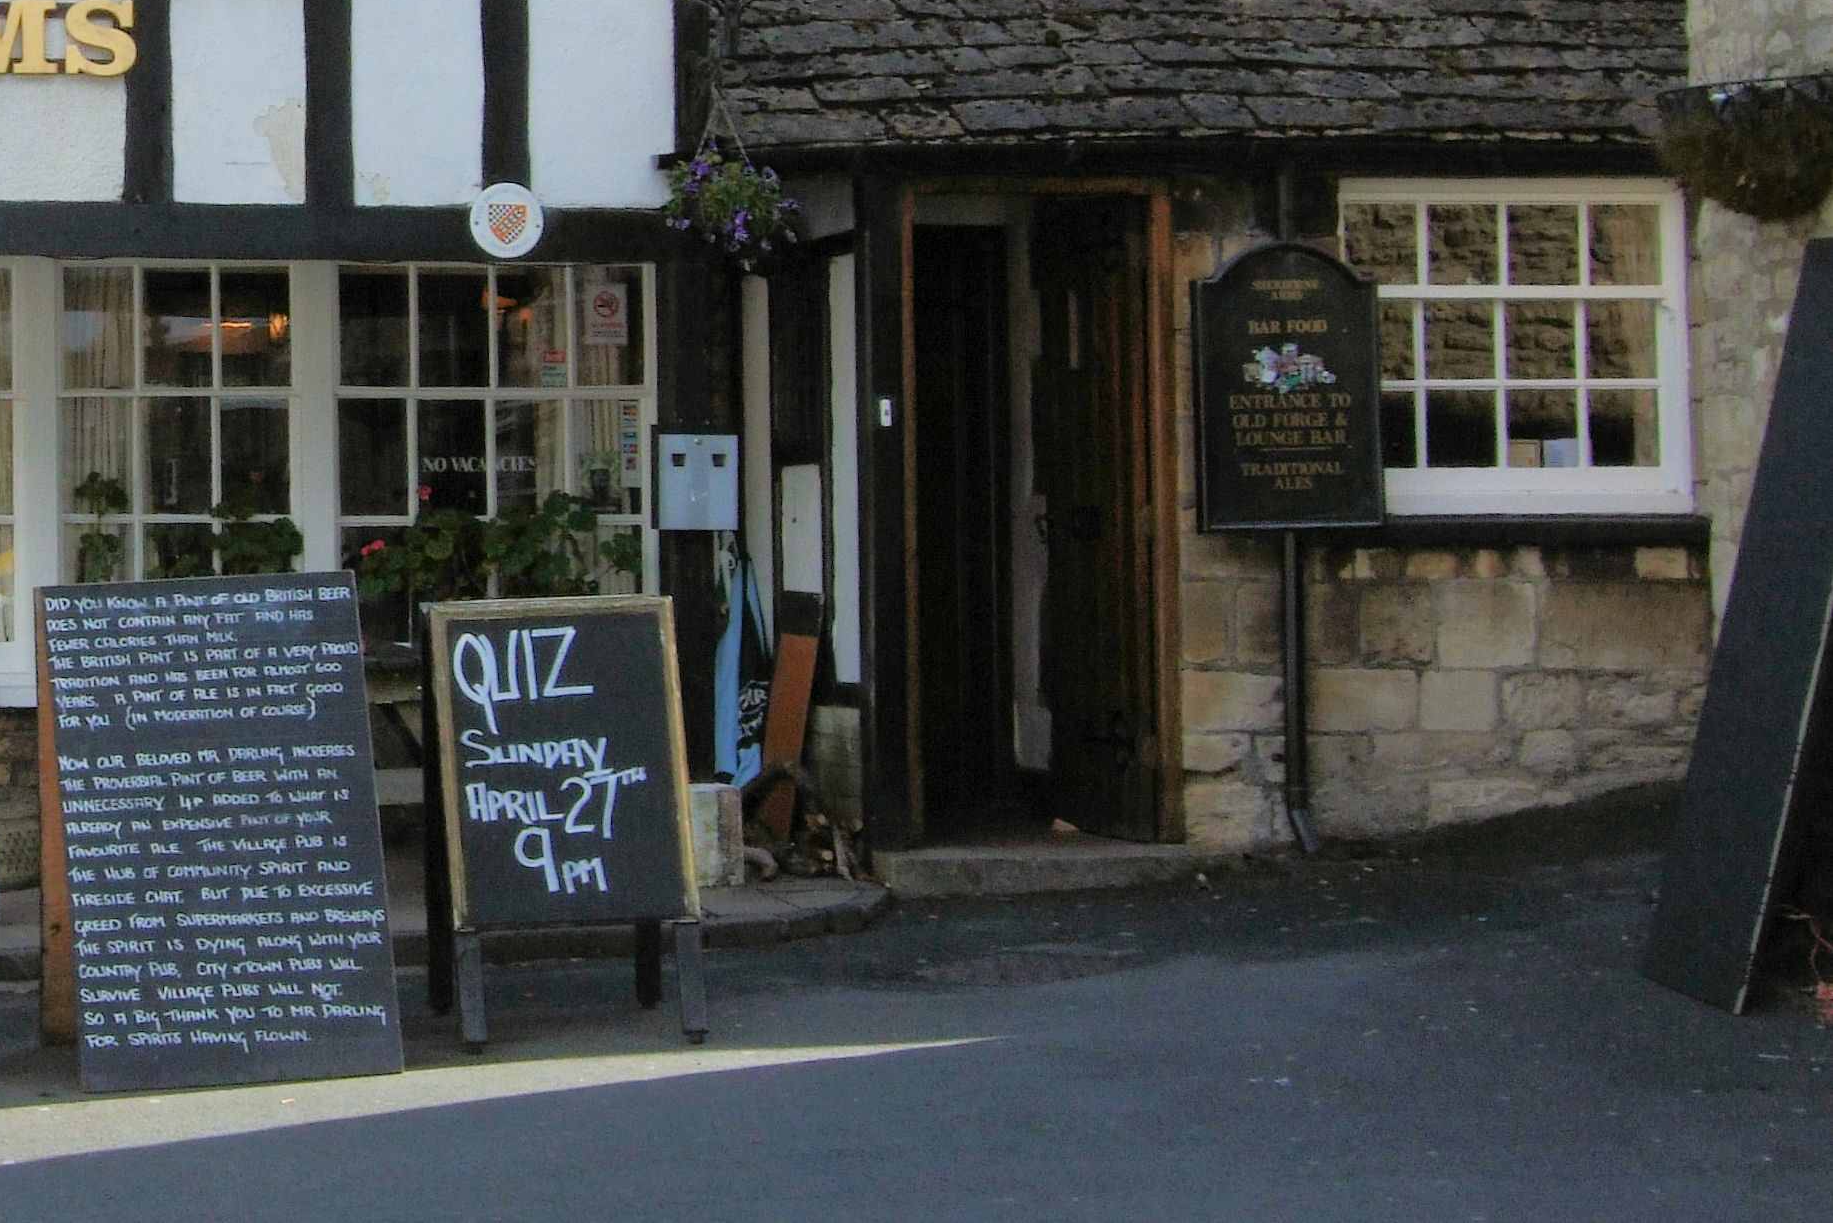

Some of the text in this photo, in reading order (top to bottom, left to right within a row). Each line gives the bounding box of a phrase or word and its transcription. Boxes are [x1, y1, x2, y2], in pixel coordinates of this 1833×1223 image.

[1248, 318, 1328, 334] BAR FOOD
[1229, 393, 1352, 409] ENTRANCE TO
[1235, 429, 1346, 446] LOUNGE BAR
[421, 457, 447, 472] NO
[45, 586, 351, 614] DID YOU KNOW A PINT OF OLD BRITISH BEER
[46, 619, 77, 632] DOES
[83, 617, 111, 630] NOT
[118, 615, 176, 628] CONTAIN
[183, 614, 211, 629] ANY
[255, 610, 284, 622] AND
[289, 609, 314, 620] HAS
[48, 638, 90, 652] FEWER
[94, 636, 157, 649] CALORIES
[162, 634, 200, 646] THAN
[48, 642, 359, 670] THE BRITISH PINT IS PART OF A VERY PROUD
[453, 625, 595, 735] QUIZ
[58, 697, 316, 731] FOR YOU (IN MODERATION OF COURSE)
[58, 744, 356, 771] NOW OUR BELOVED MR DARLING INCREASES
[460, 729, 608, 775] SUNDAY
[60, 768, 338, 792] THE PROVERBIAL PINT OF BEER WITH AN
[62, 796, 164, 813] UNNECESSARY
[212, 793, 260, 806] ADDED
[265, 791, 283, 803] TO
[289, 790, 326, 802] WHAT
[333, 789, 350, 801] IS
[465, 781, 565, 825] APRIL
[68, 843, 141, 859] FAVOURITE
[196, 838, 226, 853] THE
[232, 837, 287, 854] VILLAGE
[295, 835, 324, 849] PUB
[332, 835, 348, 847] IS
[68, 860, 352, 883] THE HUB OF COMMUNITY SPIRIT AND
[71, 892, 136, 908] FIRESIDE
[200, 887, 232, 901] BUT
[240, 886, 268, 902] DUE
[272, 884, 292, 899] TO
[298, 880, 374, 898] EXCESSIVE
[74, 931, 382, 957] THE SPIRIT IS DYING ALONG WITH YOUR
[80, 987, 142, 1004] SURVIVE
[158, 986, 215, 1005] VILLAGE
[221, 983, 261, 998] PUBS
[268, 982, 304, 996] WILL
[84, 1003, 387, 1032] SO A BIG THANK YOU TO MR DARLING
[85, 1034, 119, 1048] FOR
[128, 1032, 182, 1047] SPIRITS
[190, 1029, 249, 1053] HAVING
